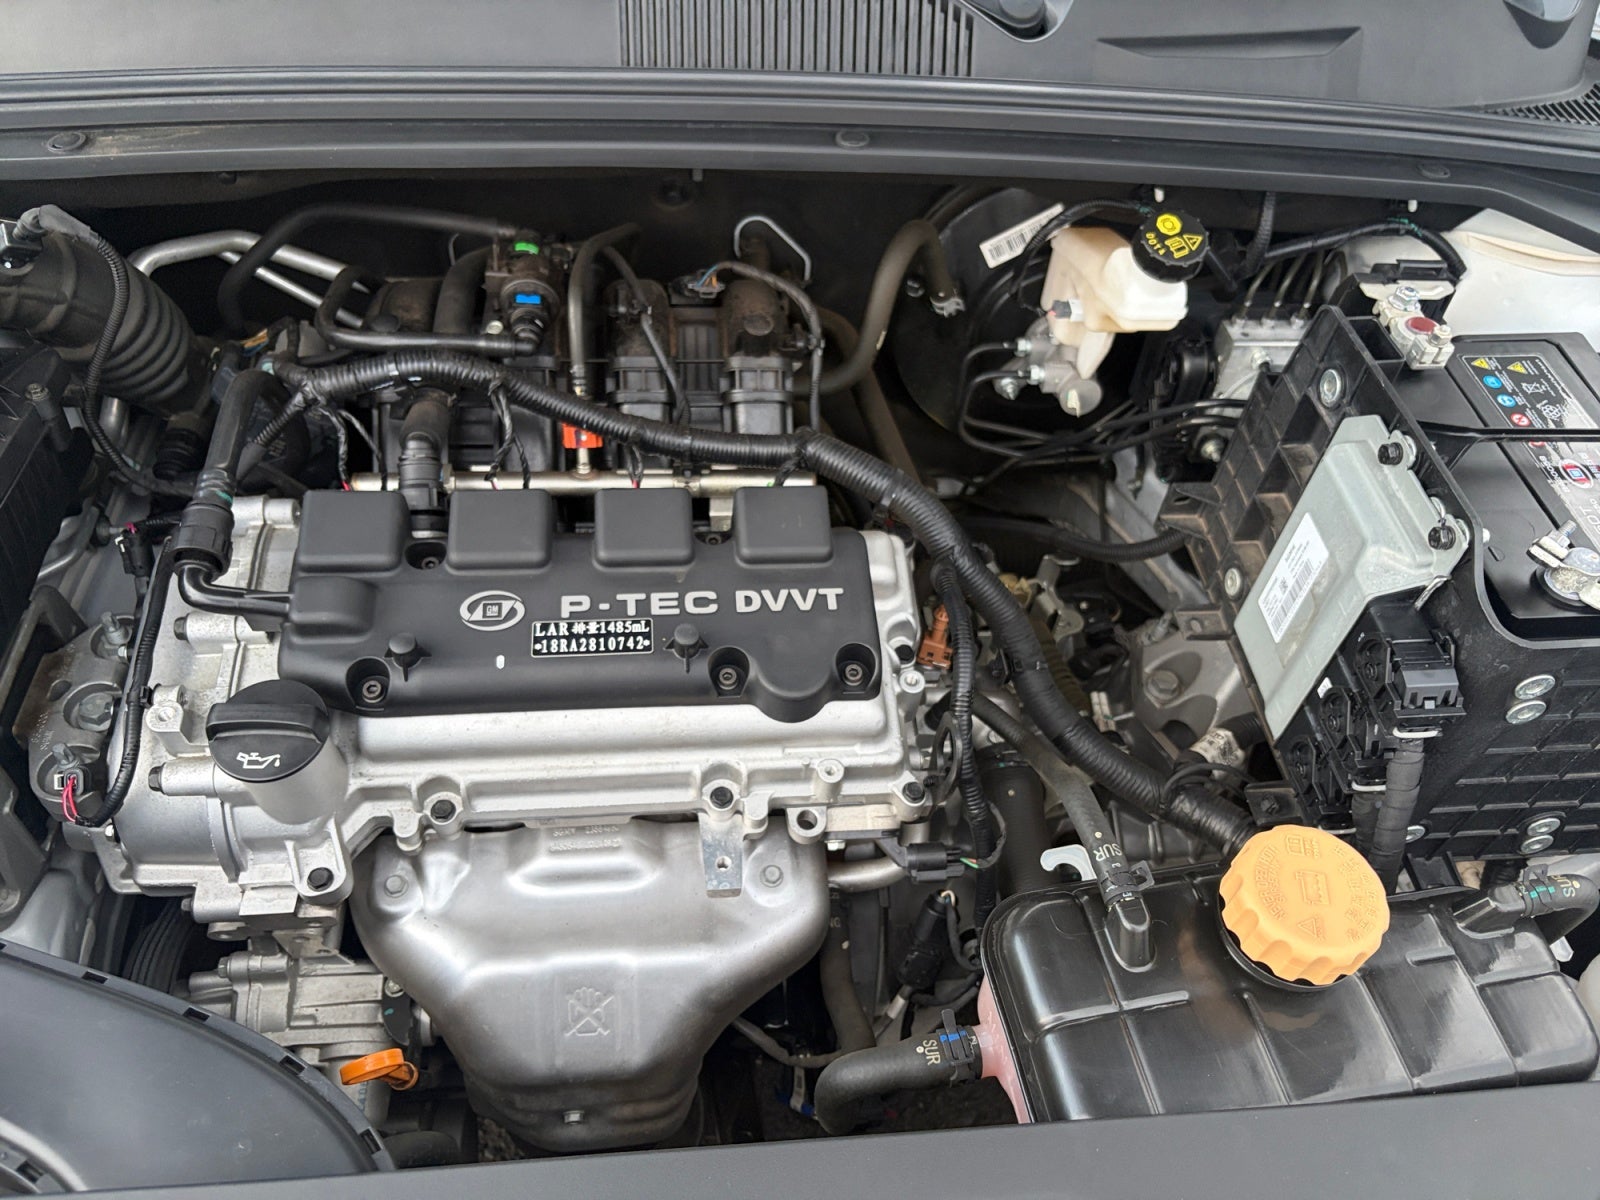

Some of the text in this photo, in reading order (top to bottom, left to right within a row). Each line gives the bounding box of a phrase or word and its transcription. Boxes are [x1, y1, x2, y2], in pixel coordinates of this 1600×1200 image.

[486, 605, 499, 616] GM
[560, 587, 844, 618] P-TEC DVVT
[535, 622, 569, 637] LAR
[1093, 842, 1123, 862] SUR
[922, 1039, 941, 1066] SUR
